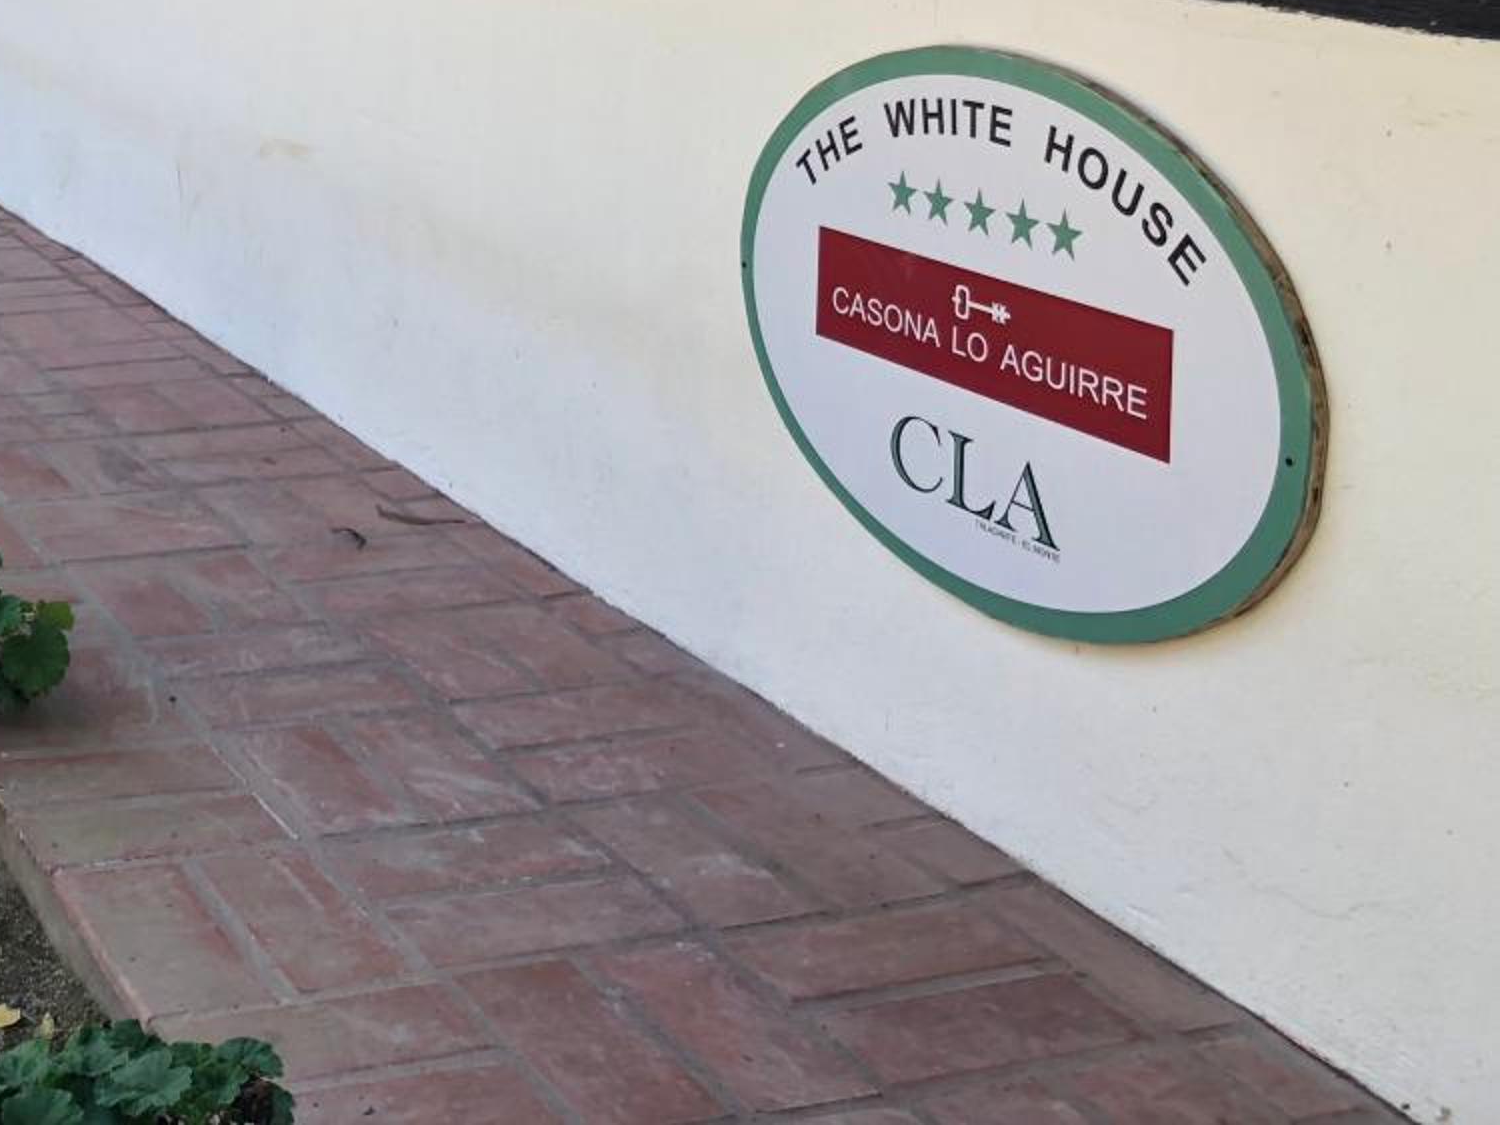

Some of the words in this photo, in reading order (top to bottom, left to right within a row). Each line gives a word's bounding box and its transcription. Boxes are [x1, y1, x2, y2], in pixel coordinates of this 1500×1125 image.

[795, 115, 864, 186] THE
[883, 97, 1013, 148] WHITE
[1044, 125, 1208, 287] HOUSE
[832, 286, 941, 349] CASONA
[950, 325, 989, 363] LO
[999, 344, 1149, 420] AGUIRRE
[889, 415, 1061, 552] CLA
